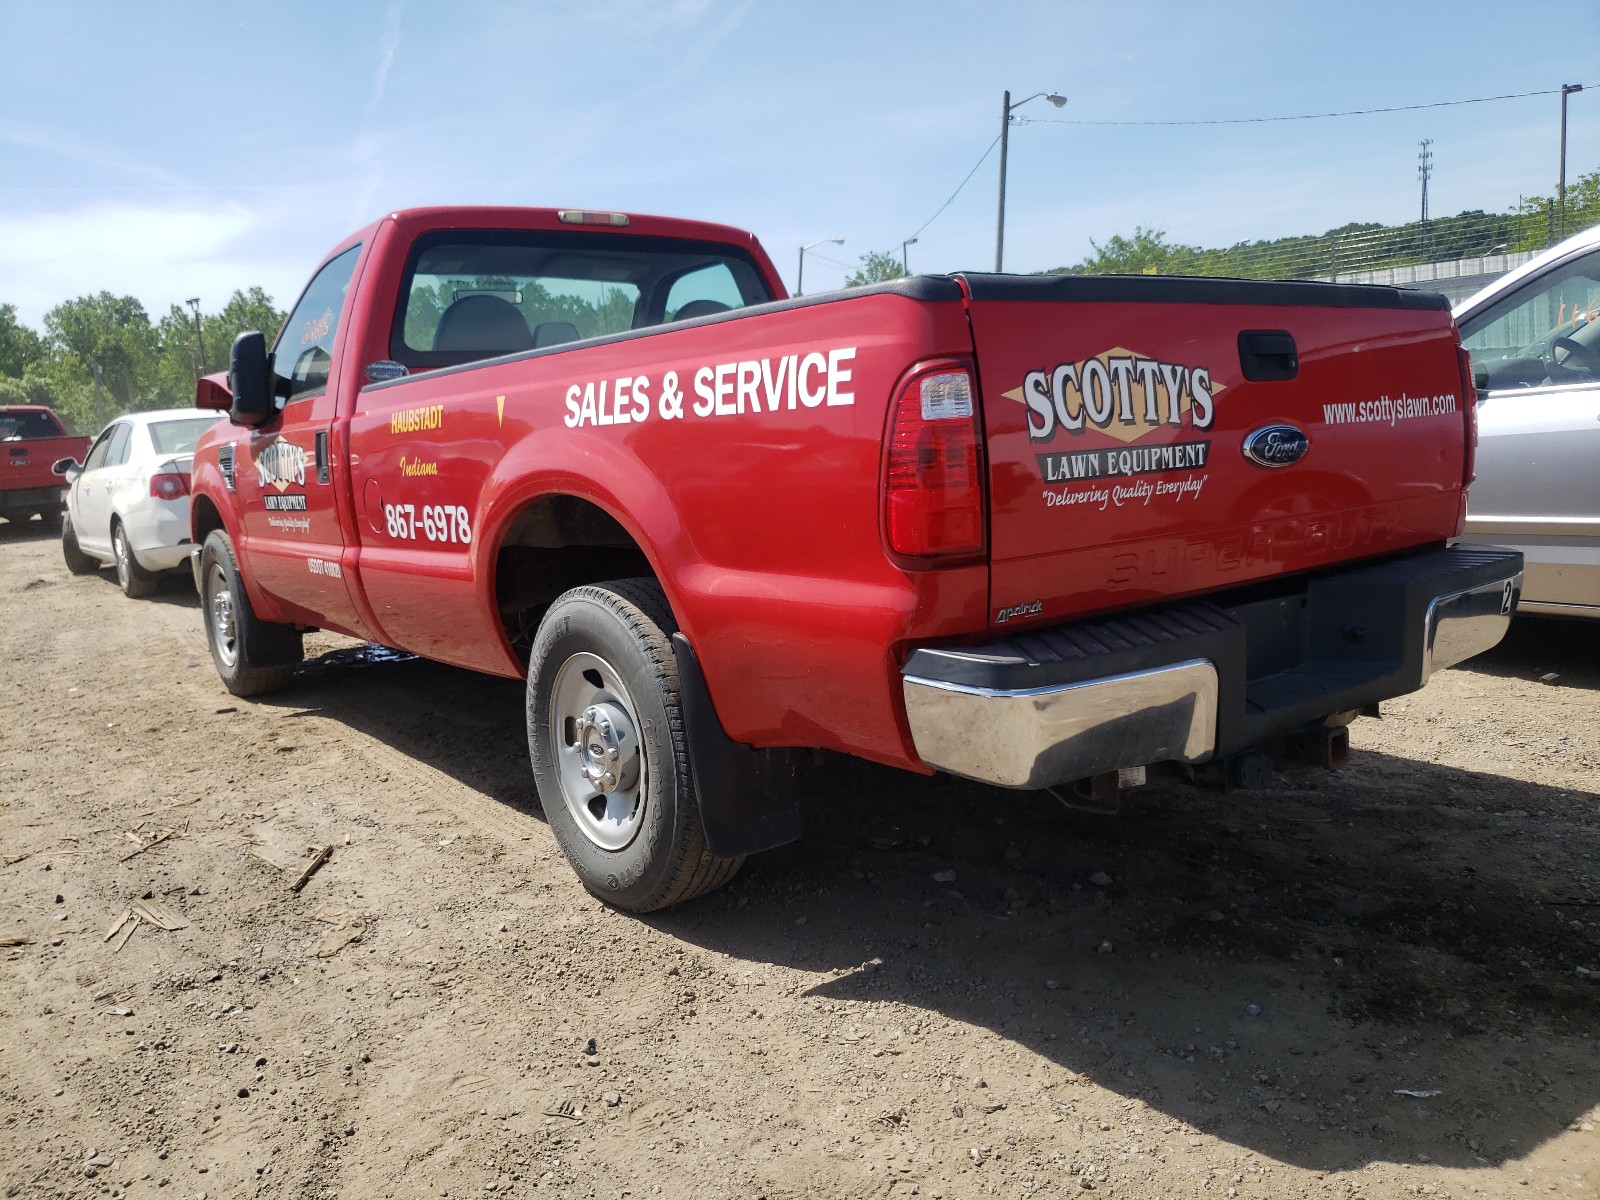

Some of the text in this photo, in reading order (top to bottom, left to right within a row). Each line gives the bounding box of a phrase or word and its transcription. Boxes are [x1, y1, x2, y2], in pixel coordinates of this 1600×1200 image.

[563, 347, 856, 428] SALES & SERVICE
[1023, 356, 1214, 442] SCOTTY'S
[391, 405, 443, 434] HAUBSTADT
[1323, 393, 1456, 427] www.scottyslawn.com
[258, 440, 306, 488] SCOTTY'S
[400, 456, 438, 477] Indiana
[1047, 443, 1206, 480] LAWN EQUIPMENT
[278, 495, 306, 511] EQUIPMENT
[1112, 480, 1154, 507] Quality
[1156, 475, 1208, 502] Everyday"
[385, 504, 472, 544] 867-6978
[1501, 580, 1512, 614] 2
[554, 615, 571, 637] HT
